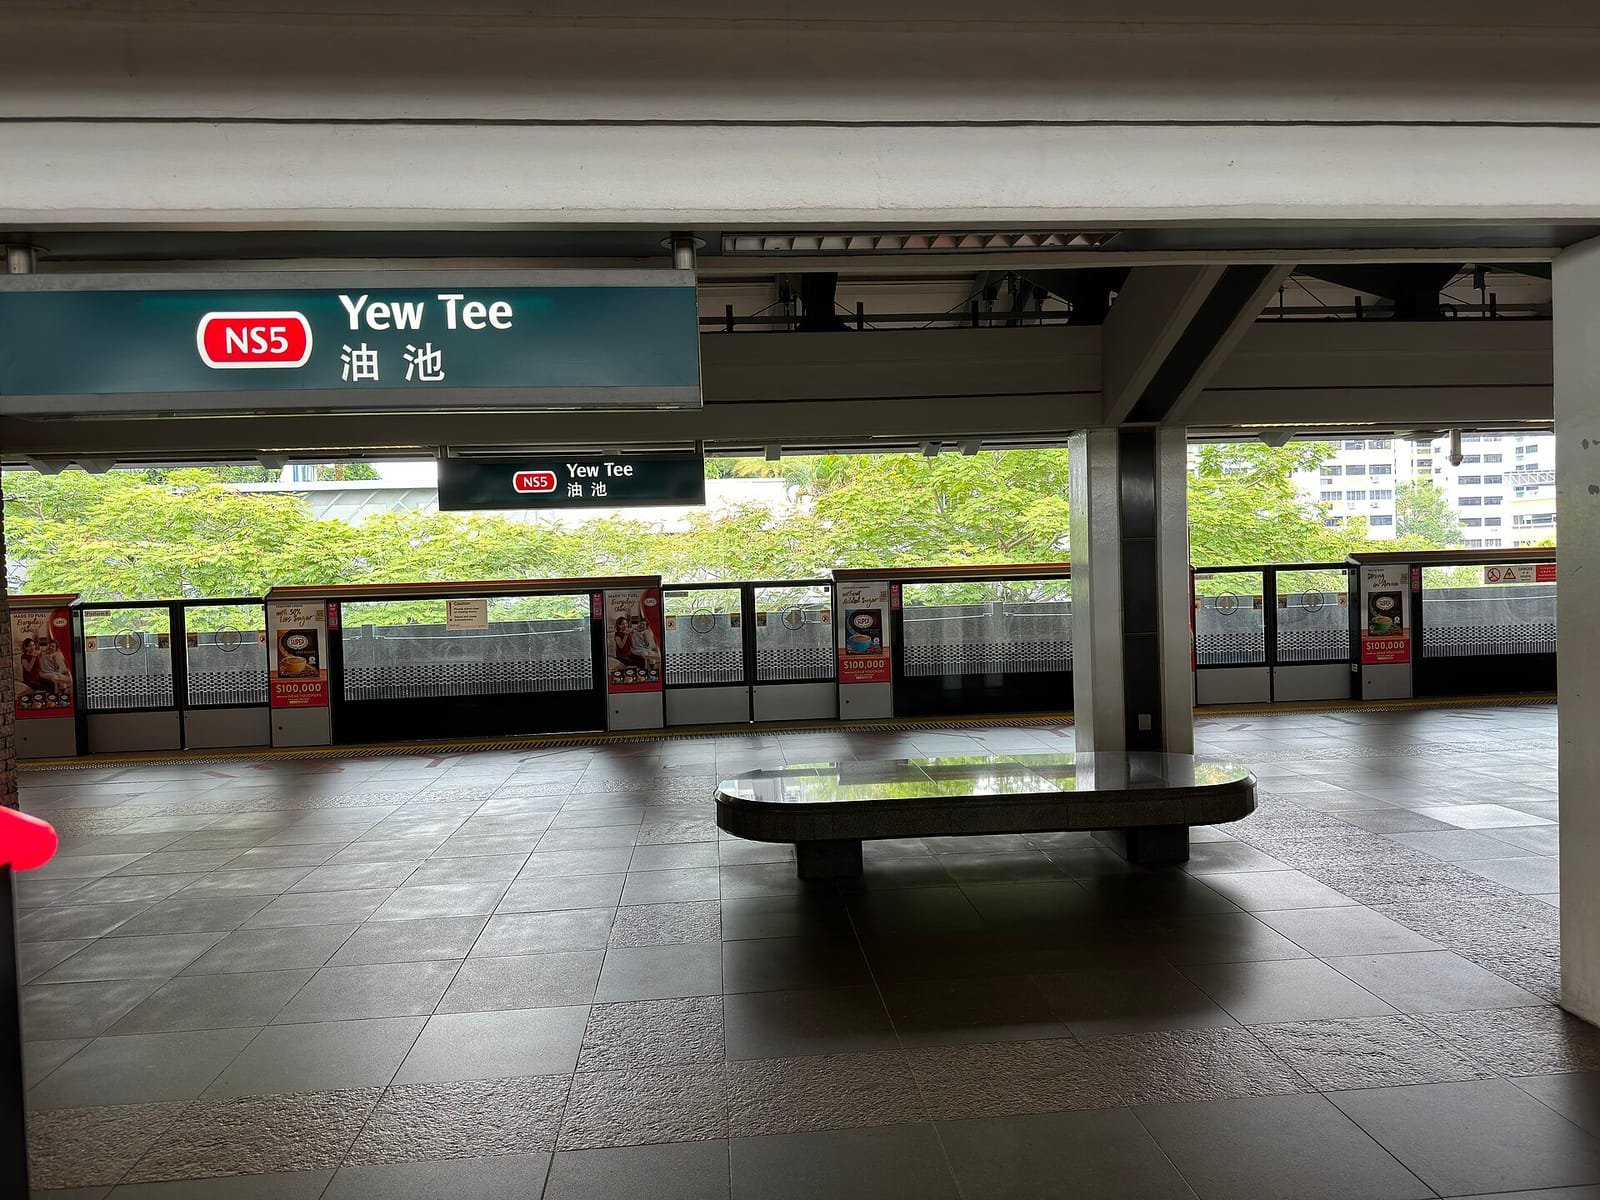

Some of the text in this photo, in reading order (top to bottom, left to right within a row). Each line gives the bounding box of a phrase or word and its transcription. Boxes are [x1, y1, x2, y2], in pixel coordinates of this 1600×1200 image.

[338, 293, 513, 330] Yew Tee
[225, 326, 289, 354] NS5
[566, 462, 633, 478] Yew Tee
[523, 476, 548, 488] NS5
[1366, 641, 1405, 651] $100,000
[843, 660, 885, 670] $100,000
[276, 683, 322, 694] $100,000
